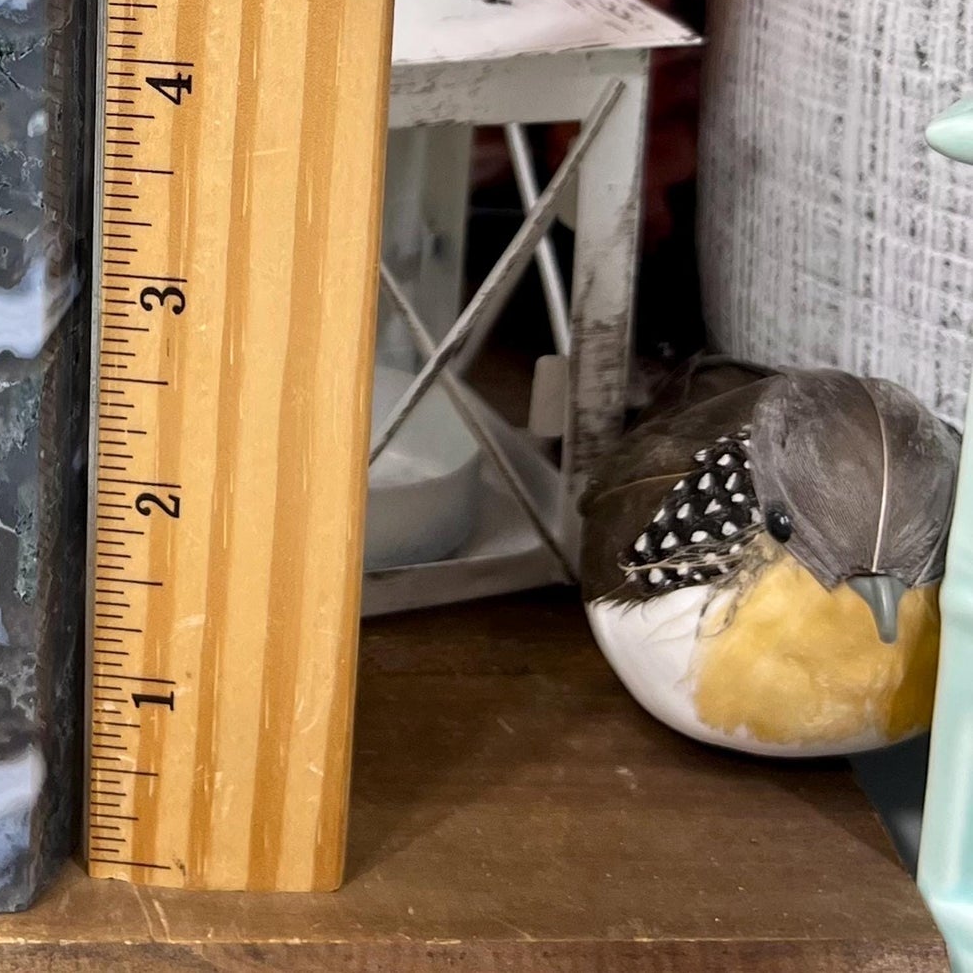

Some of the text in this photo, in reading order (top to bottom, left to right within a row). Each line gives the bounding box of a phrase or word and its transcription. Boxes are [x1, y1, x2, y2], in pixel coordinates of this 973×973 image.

[145, 71, 193, 105] 4
[139, 286, 186, 315] 3
[135, 492, 181, 519] 2
[131, 691, 175, 711] 1
